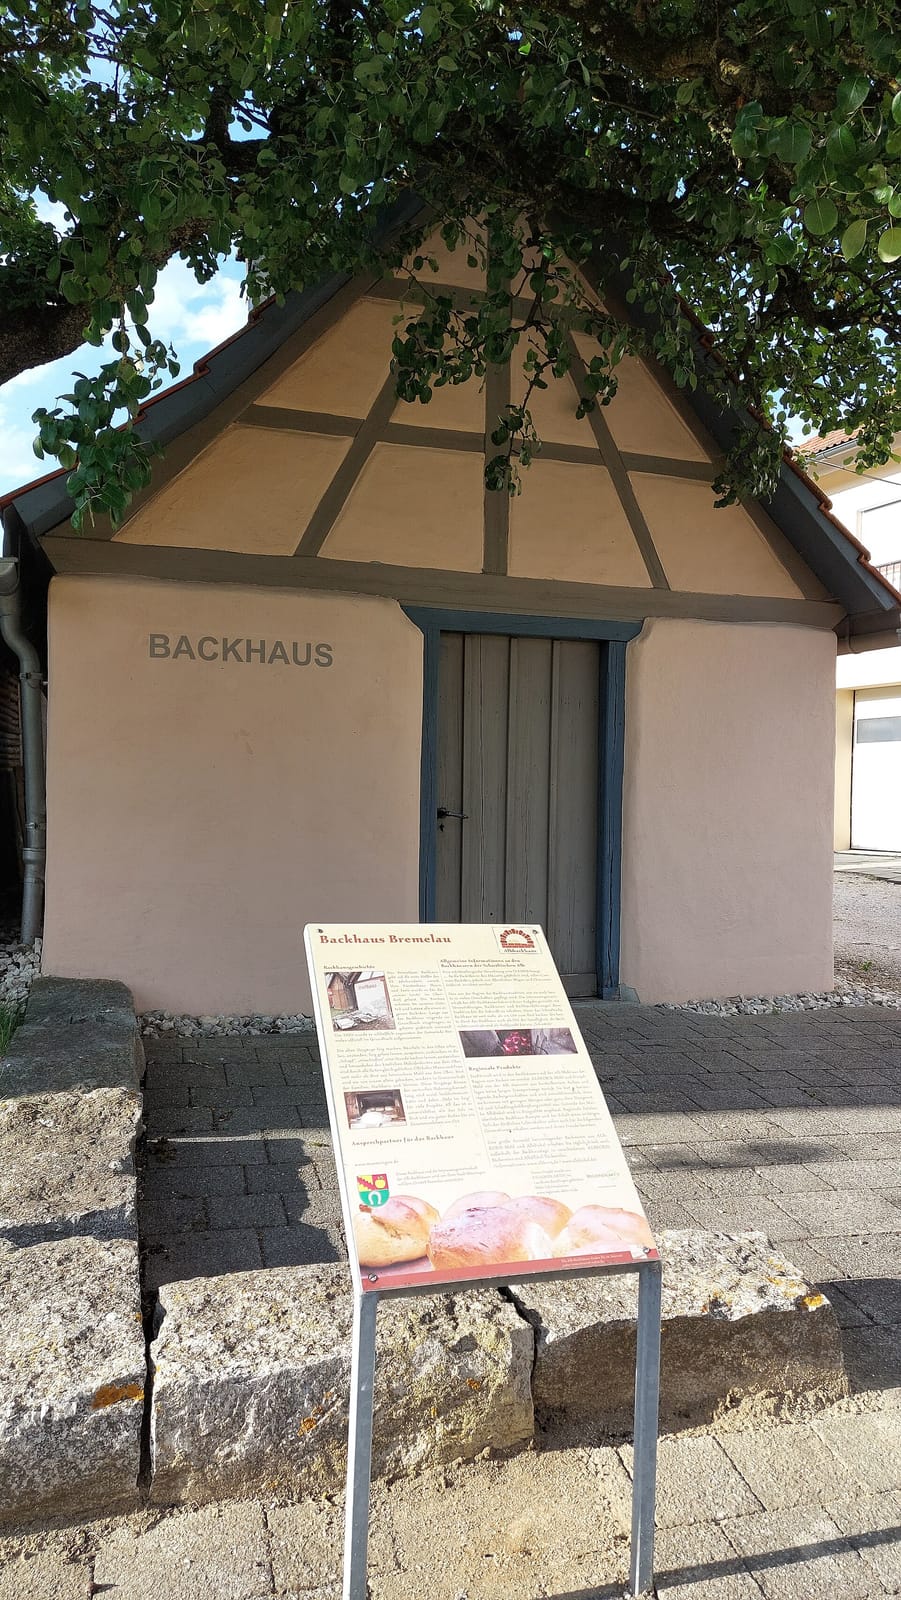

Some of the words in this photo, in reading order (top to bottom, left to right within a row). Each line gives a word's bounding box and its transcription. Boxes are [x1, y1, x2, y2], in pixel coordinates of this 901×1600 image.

[149, 633, 334, 668] BACKHAUS
[319, 934, 385, 944] Backhaus
[389, 934, 452, 944] Bremelau
